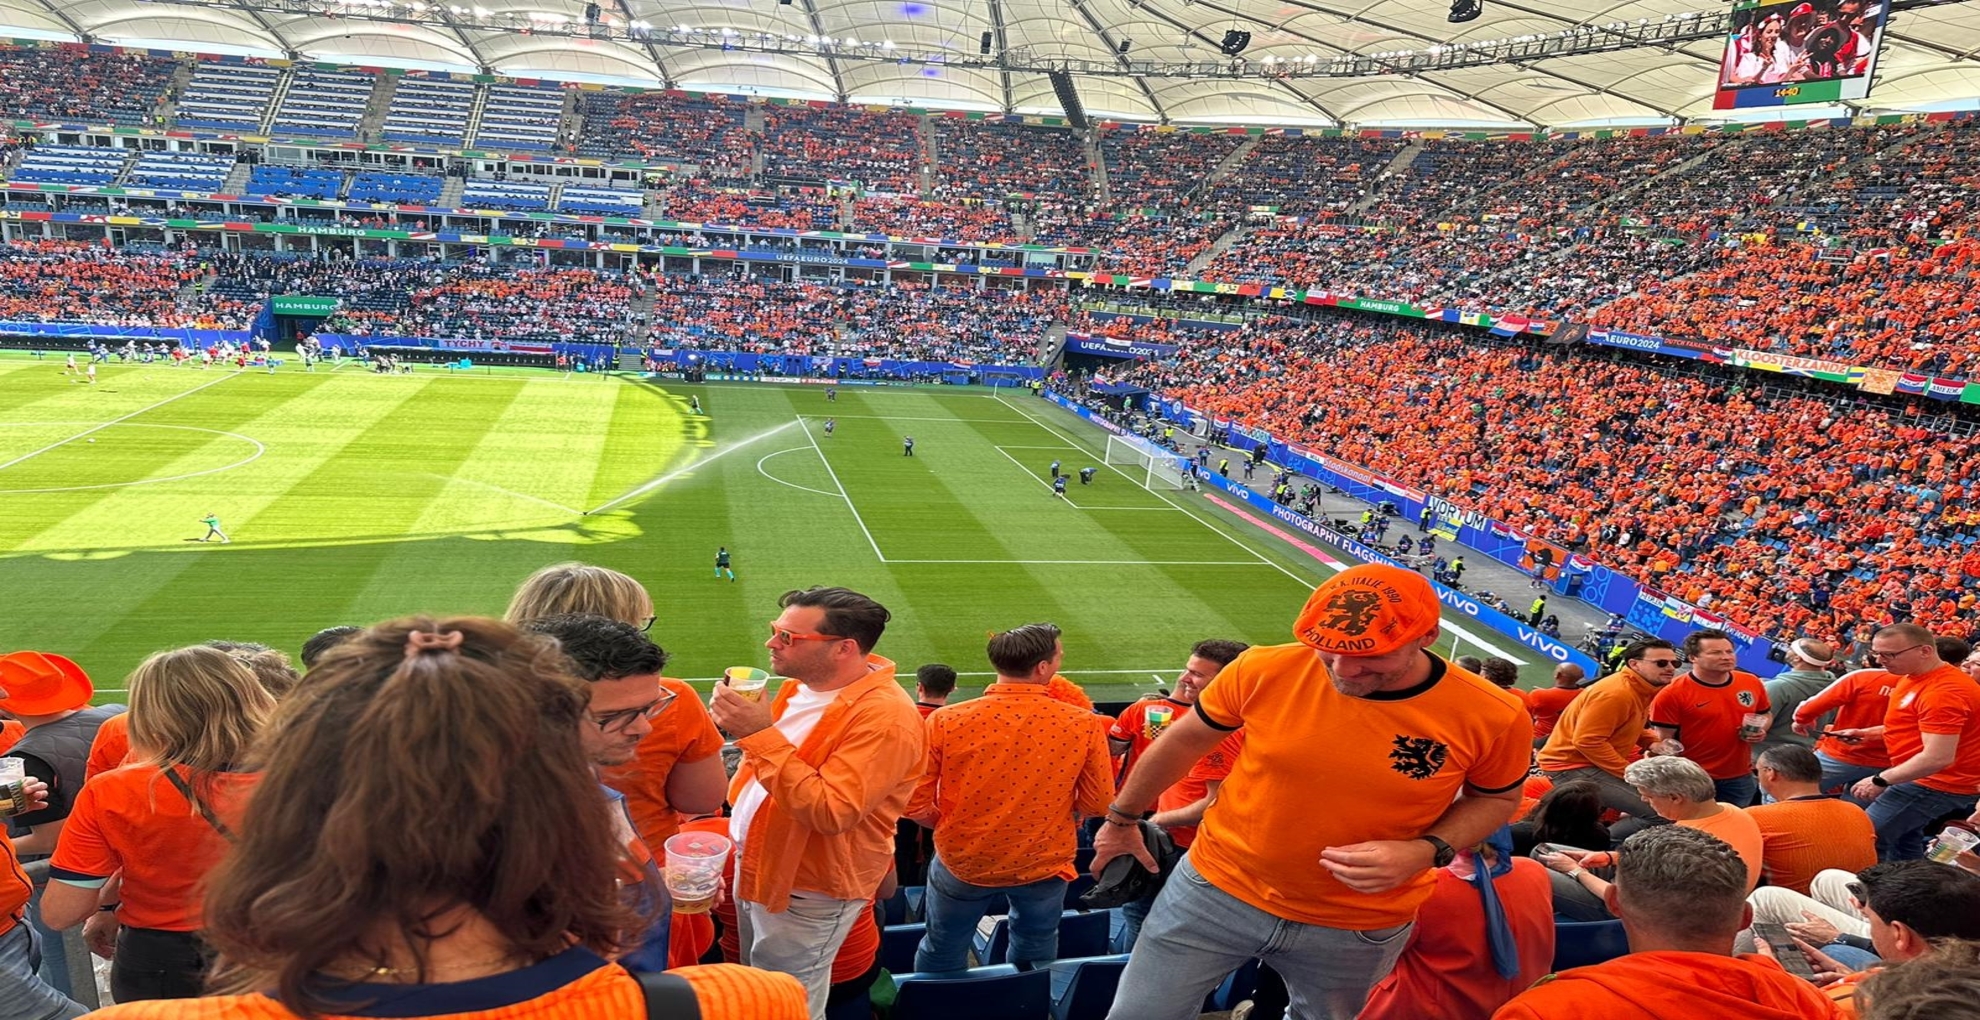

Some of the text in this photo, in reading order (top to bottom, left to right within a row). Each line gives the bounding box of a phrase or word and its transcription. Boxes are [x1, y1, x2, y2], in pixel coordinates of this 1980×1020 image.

[297, 226, 366, 236] HAMBURG
[1359, 300, 1400, 312] HAMBURG
[443, 340, 486, 348] TYCHY
[1737, 350, 1847, 374] KLOOSTERZANDE
[1226, 482, 1249, 500] vivo
[1272, 504, 1340, 546] PHOTOGRAPHY
[1352, 577, 1385, 589] ITALIE
[1381, 586, 1402, 603] 1990
[1436, 586, 1479, 616] vivo
[1303, 627, 1376, 651] HOLLAND
[1517, 626, 1569, 661] vivo
